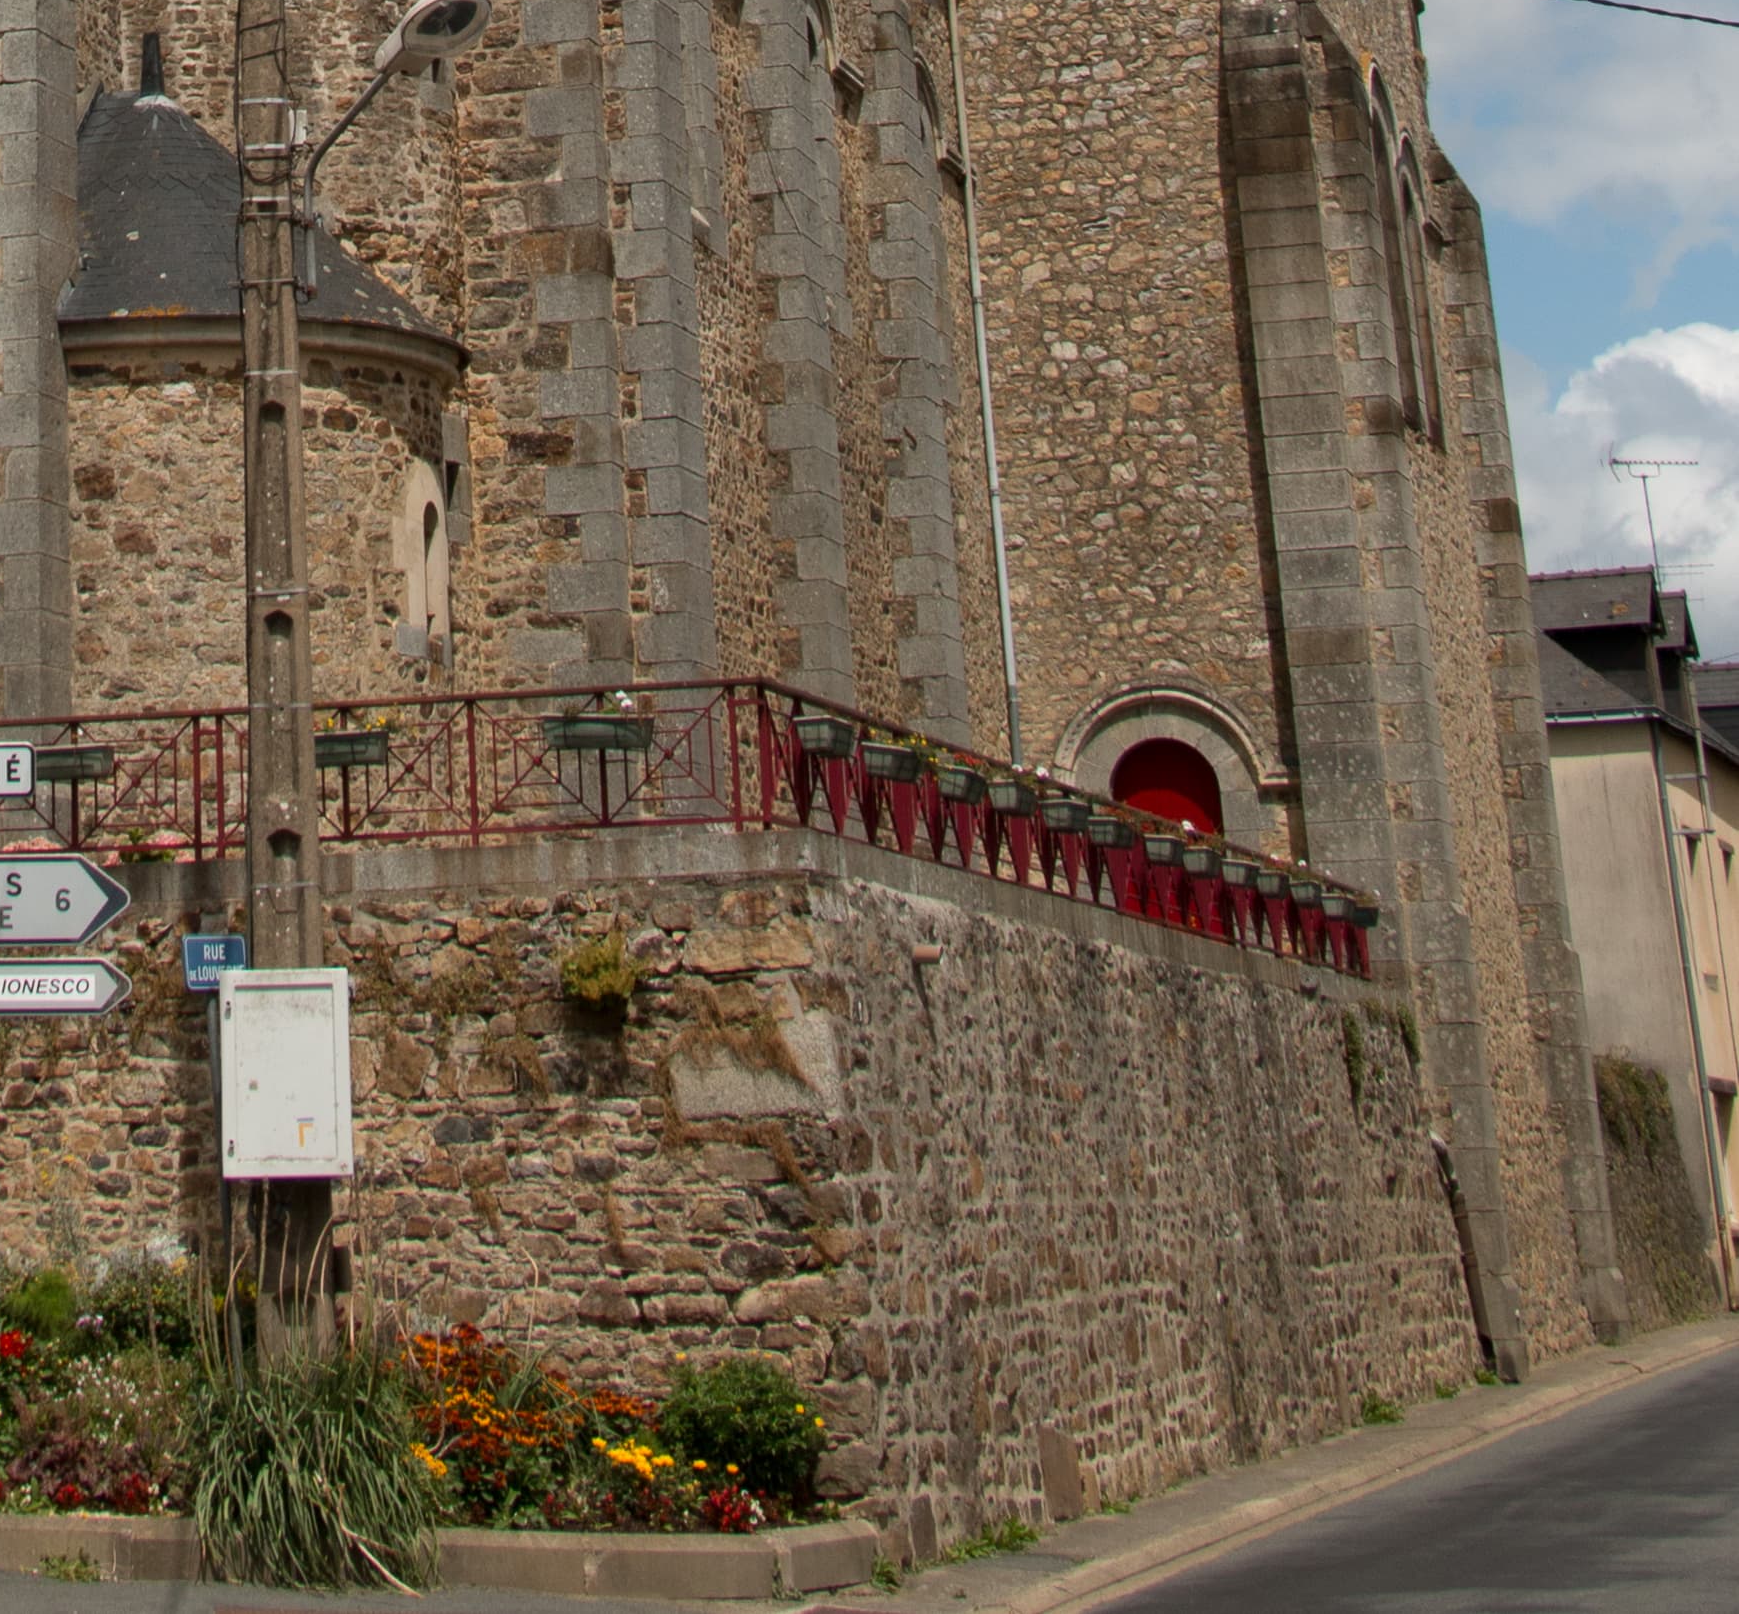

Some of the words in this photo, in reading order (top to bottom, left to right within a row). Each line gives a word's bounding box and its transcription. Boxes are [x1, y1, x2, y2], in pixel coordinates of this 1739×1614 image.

[55, 888, 71, 912] 6
[203, 943, 226, 961] RUE
[1, 978, 90, 996] IONESCO
